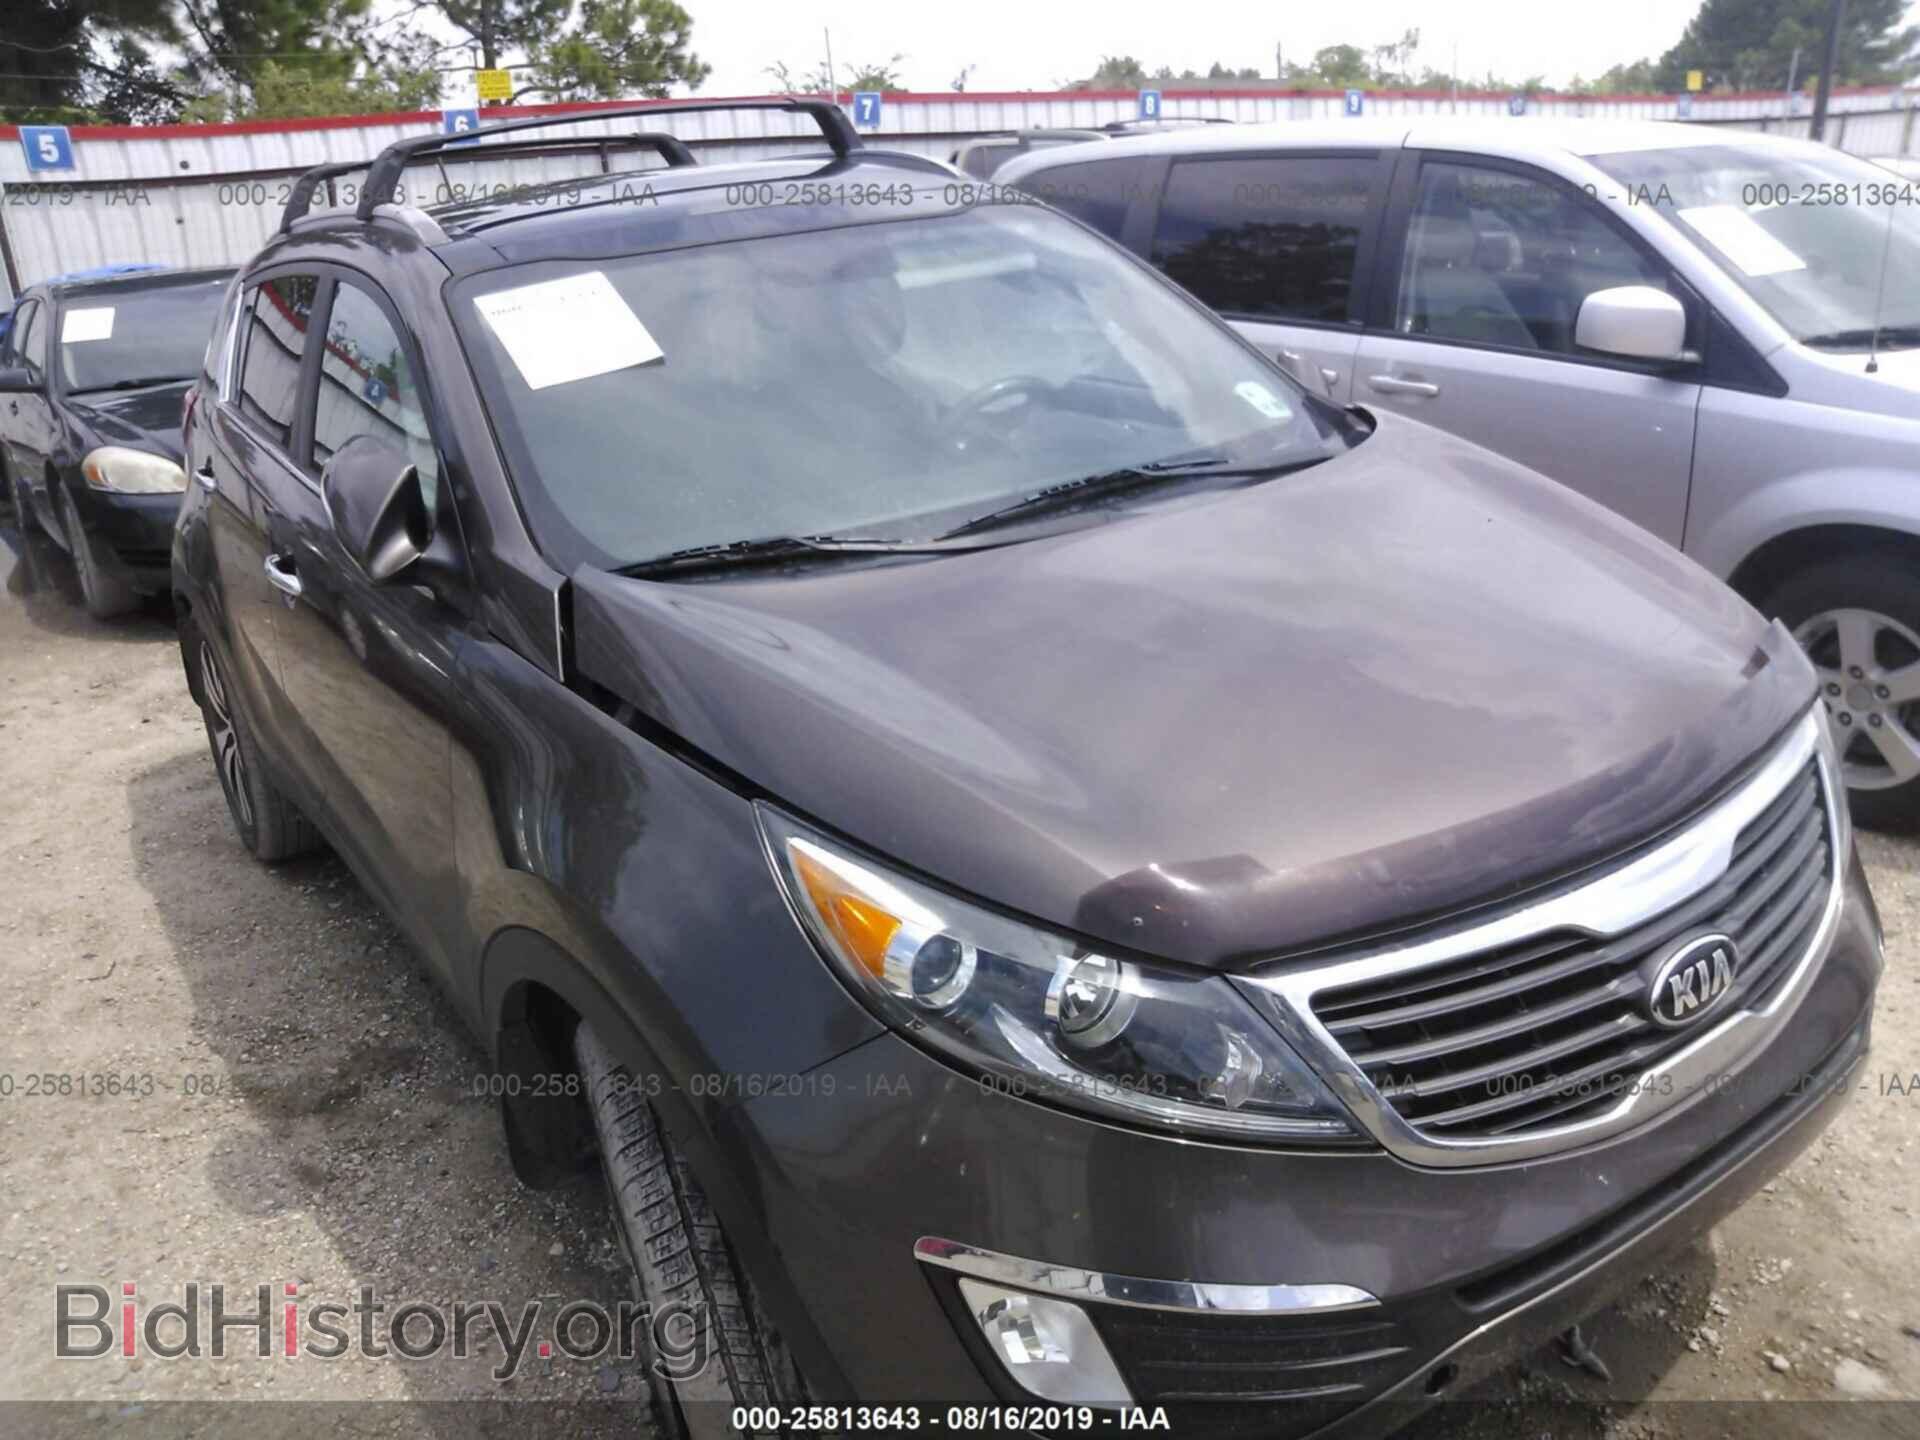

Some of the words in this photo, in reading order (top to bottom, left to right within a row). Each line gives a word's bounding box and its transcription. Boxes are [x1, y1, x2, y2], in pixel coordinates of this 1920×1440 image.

[862, 99, 873, 120] 7
[1145, 96, 1154, 114] 8
[38, 135, 60, 163] 5
[1669, 948, 1731, 1016] KIA
